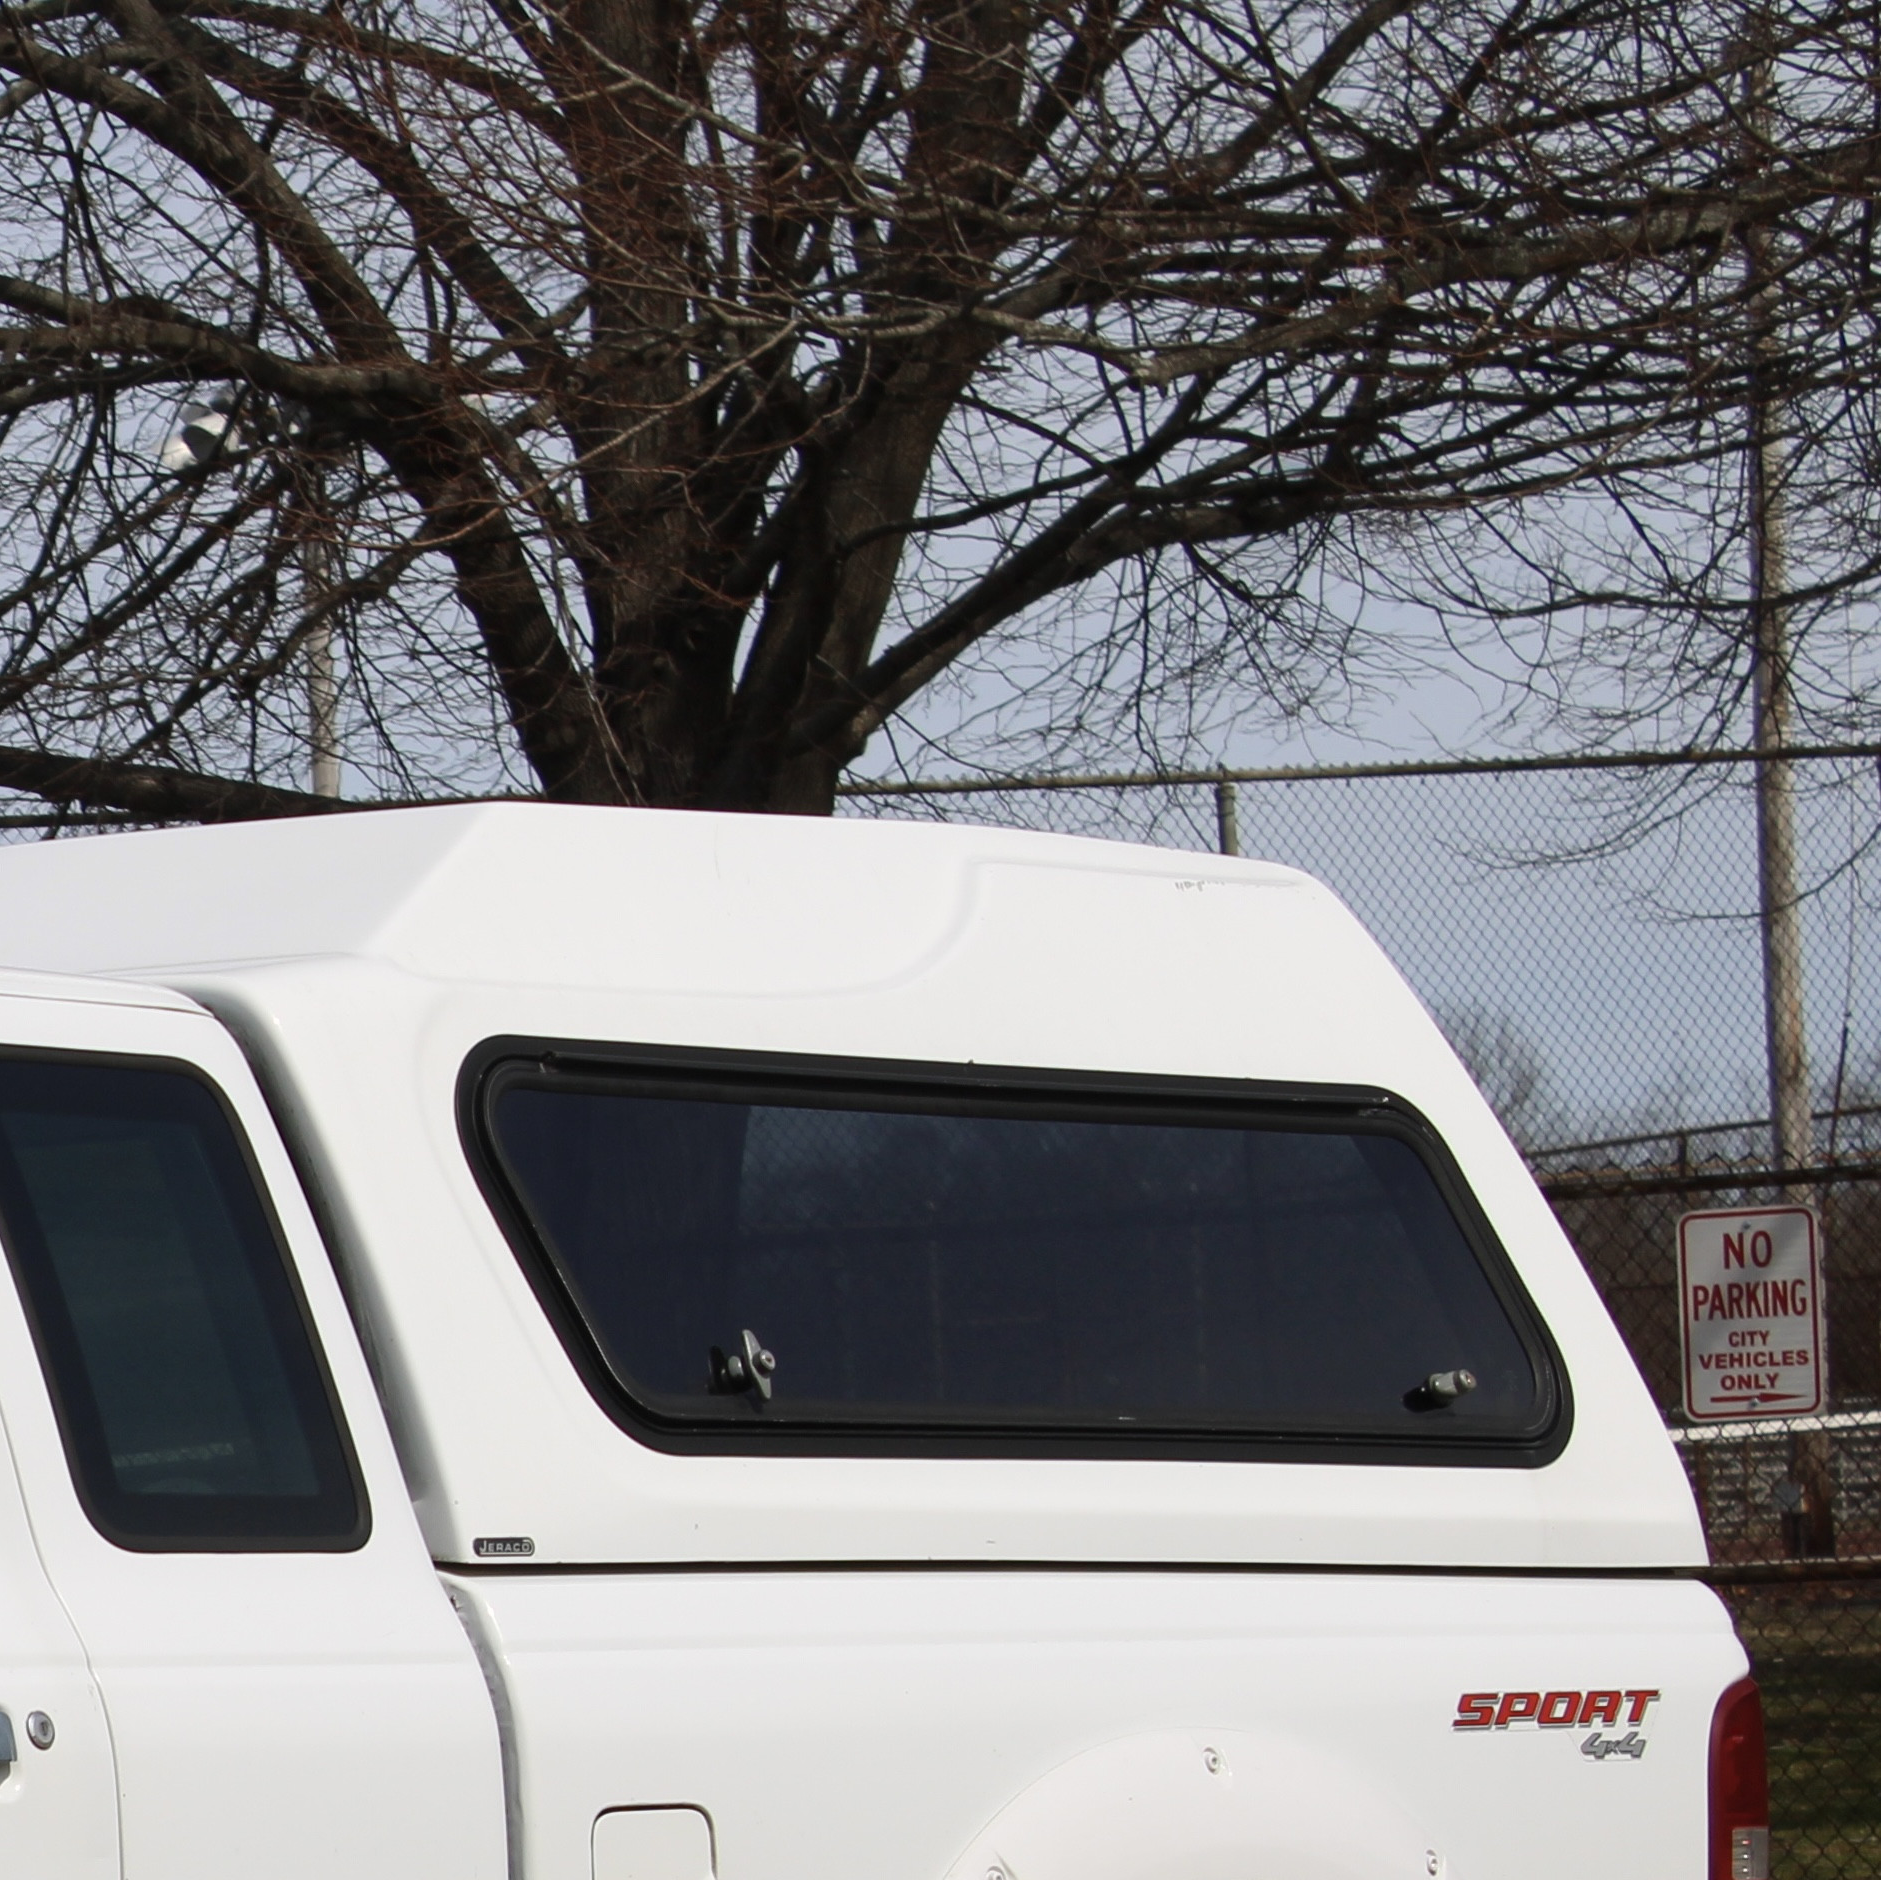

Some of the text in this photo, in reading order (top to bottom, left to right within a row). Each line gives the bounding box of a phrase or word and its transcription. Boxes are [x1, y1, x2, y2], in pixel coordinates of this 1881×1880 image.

[1723, 1230, 1772, 1269] NO
[1693, 1279, 1807, 1321] PARKING
[1728, 1330, 1770, 1347] CITY
[1699, 1350, 1809, 1370] VEHICLES
[1720, 1373, 1779, 1391] ONLY
[1452, 1690, 1661, 1731] SPORT
[1580, 1732, 1646, 1759] 4x4
